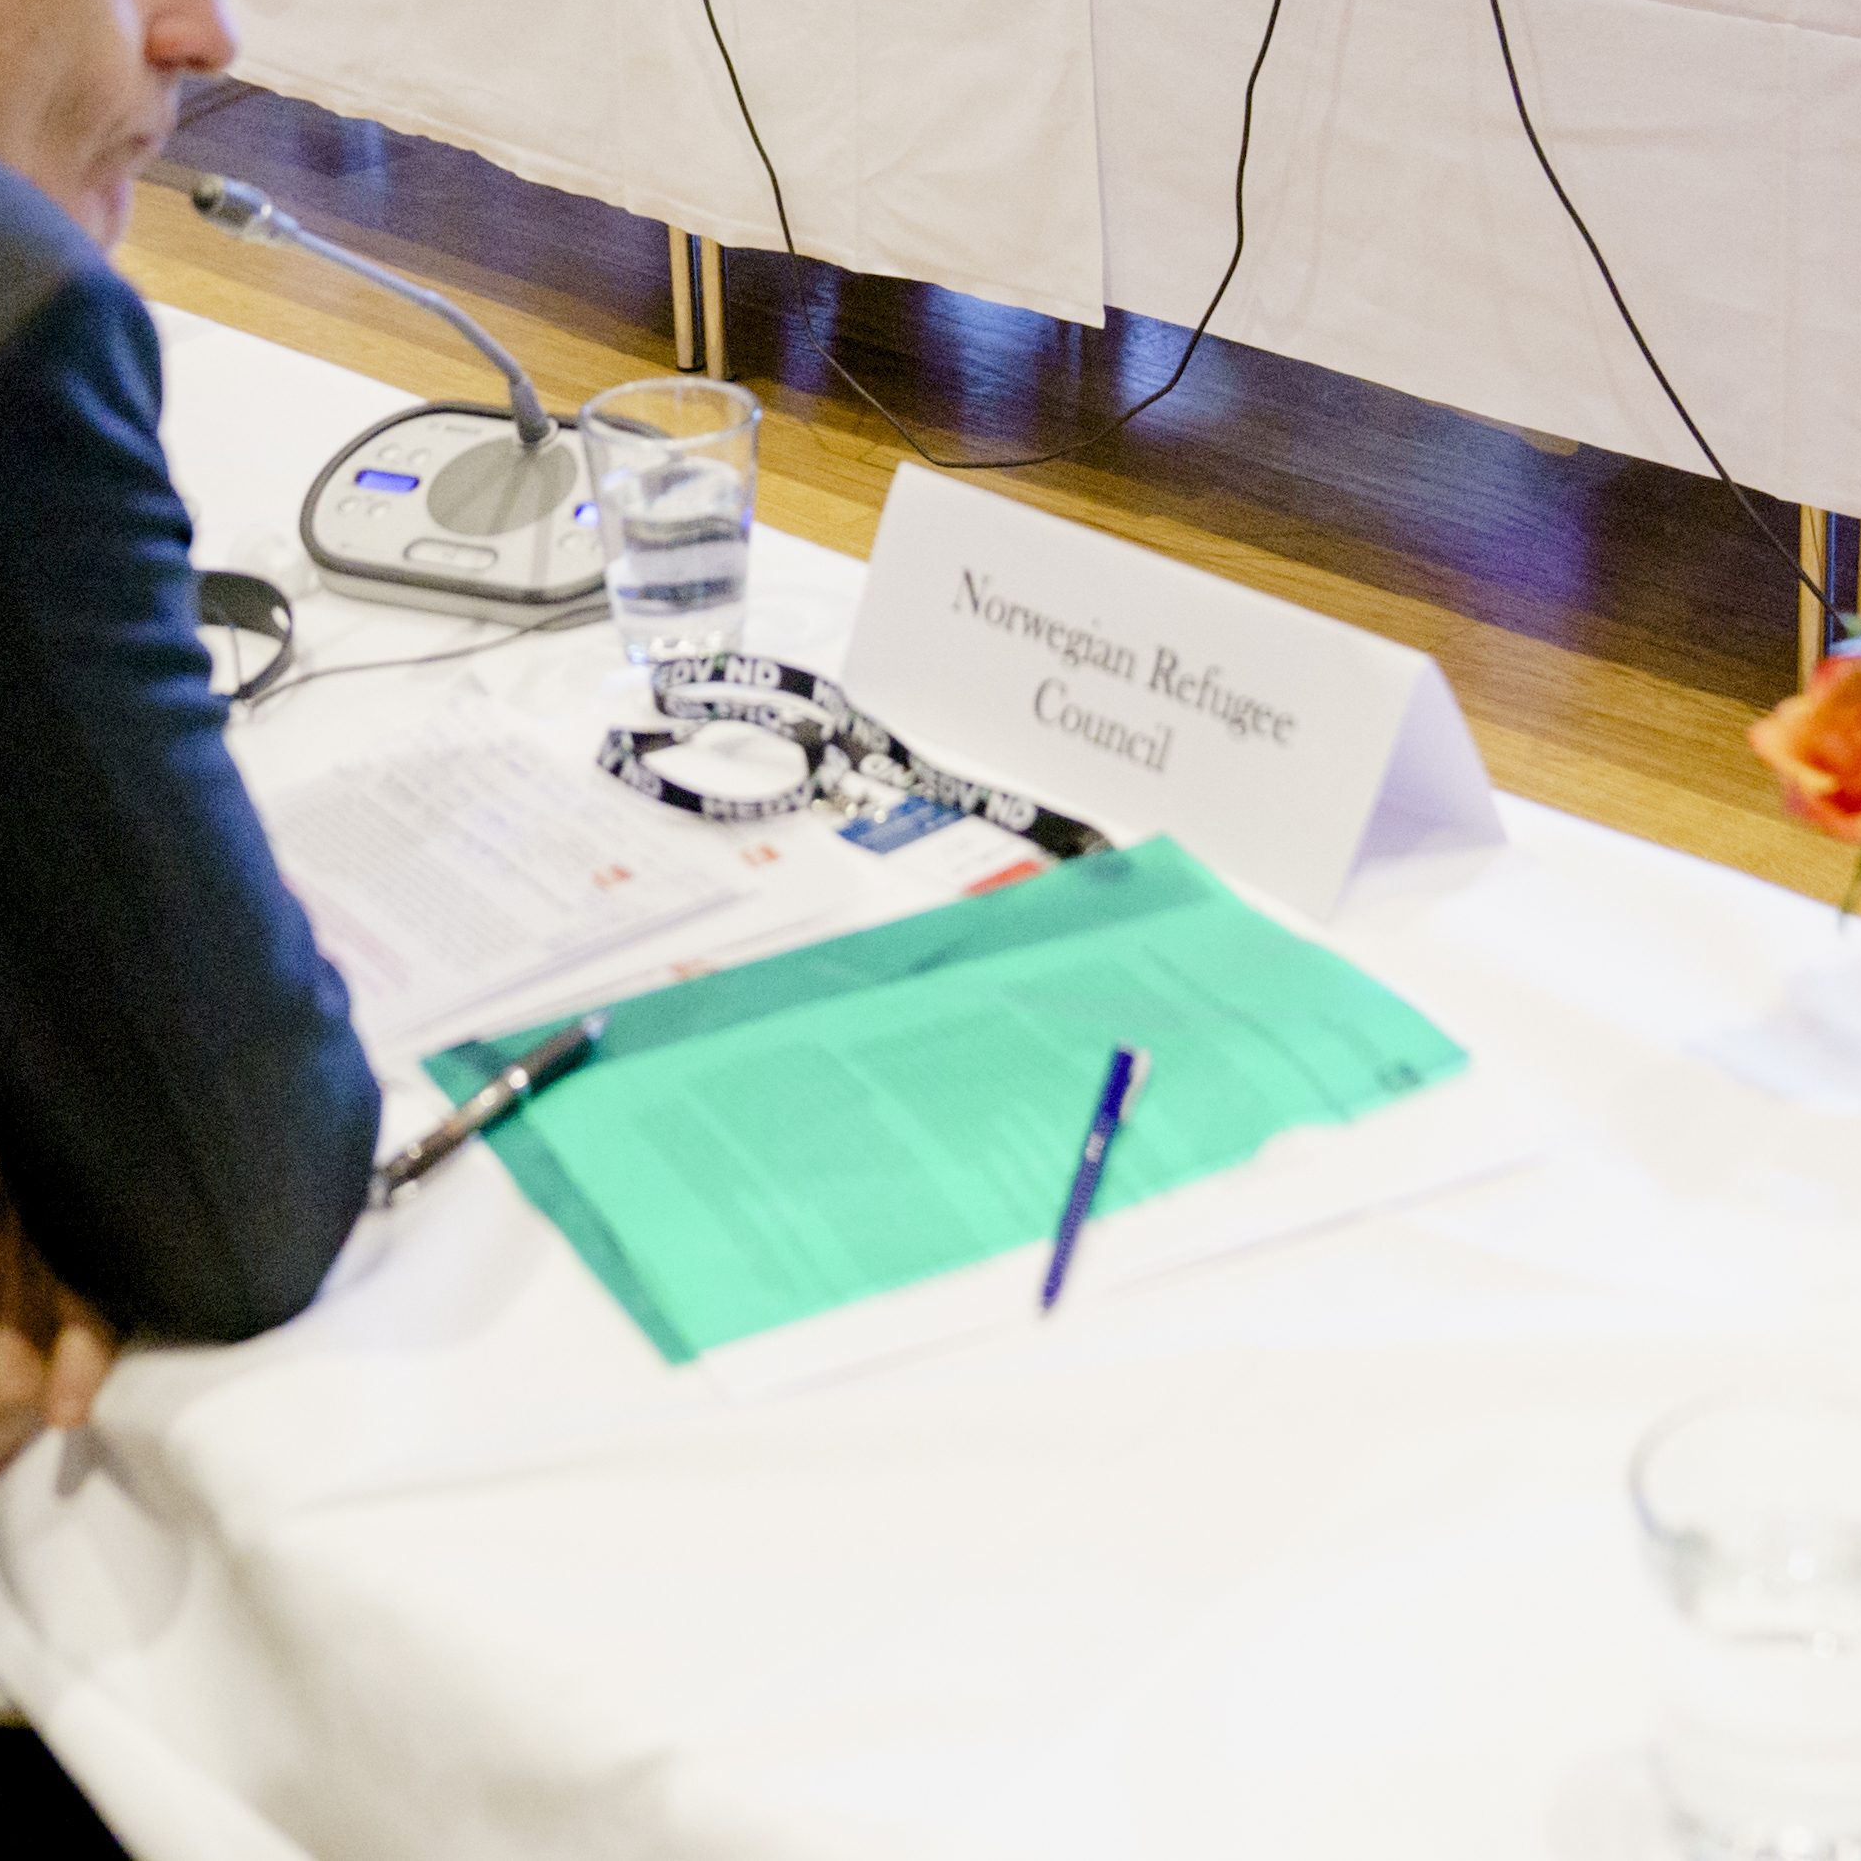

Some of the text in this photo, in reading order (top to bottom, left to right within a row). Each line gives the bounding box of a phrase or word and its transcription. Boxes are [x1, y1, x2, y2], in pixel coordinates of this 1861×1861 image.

[952, 567, 1299, 746] Norwegian Refugee
[1031, 679, 1176, 774] Council
